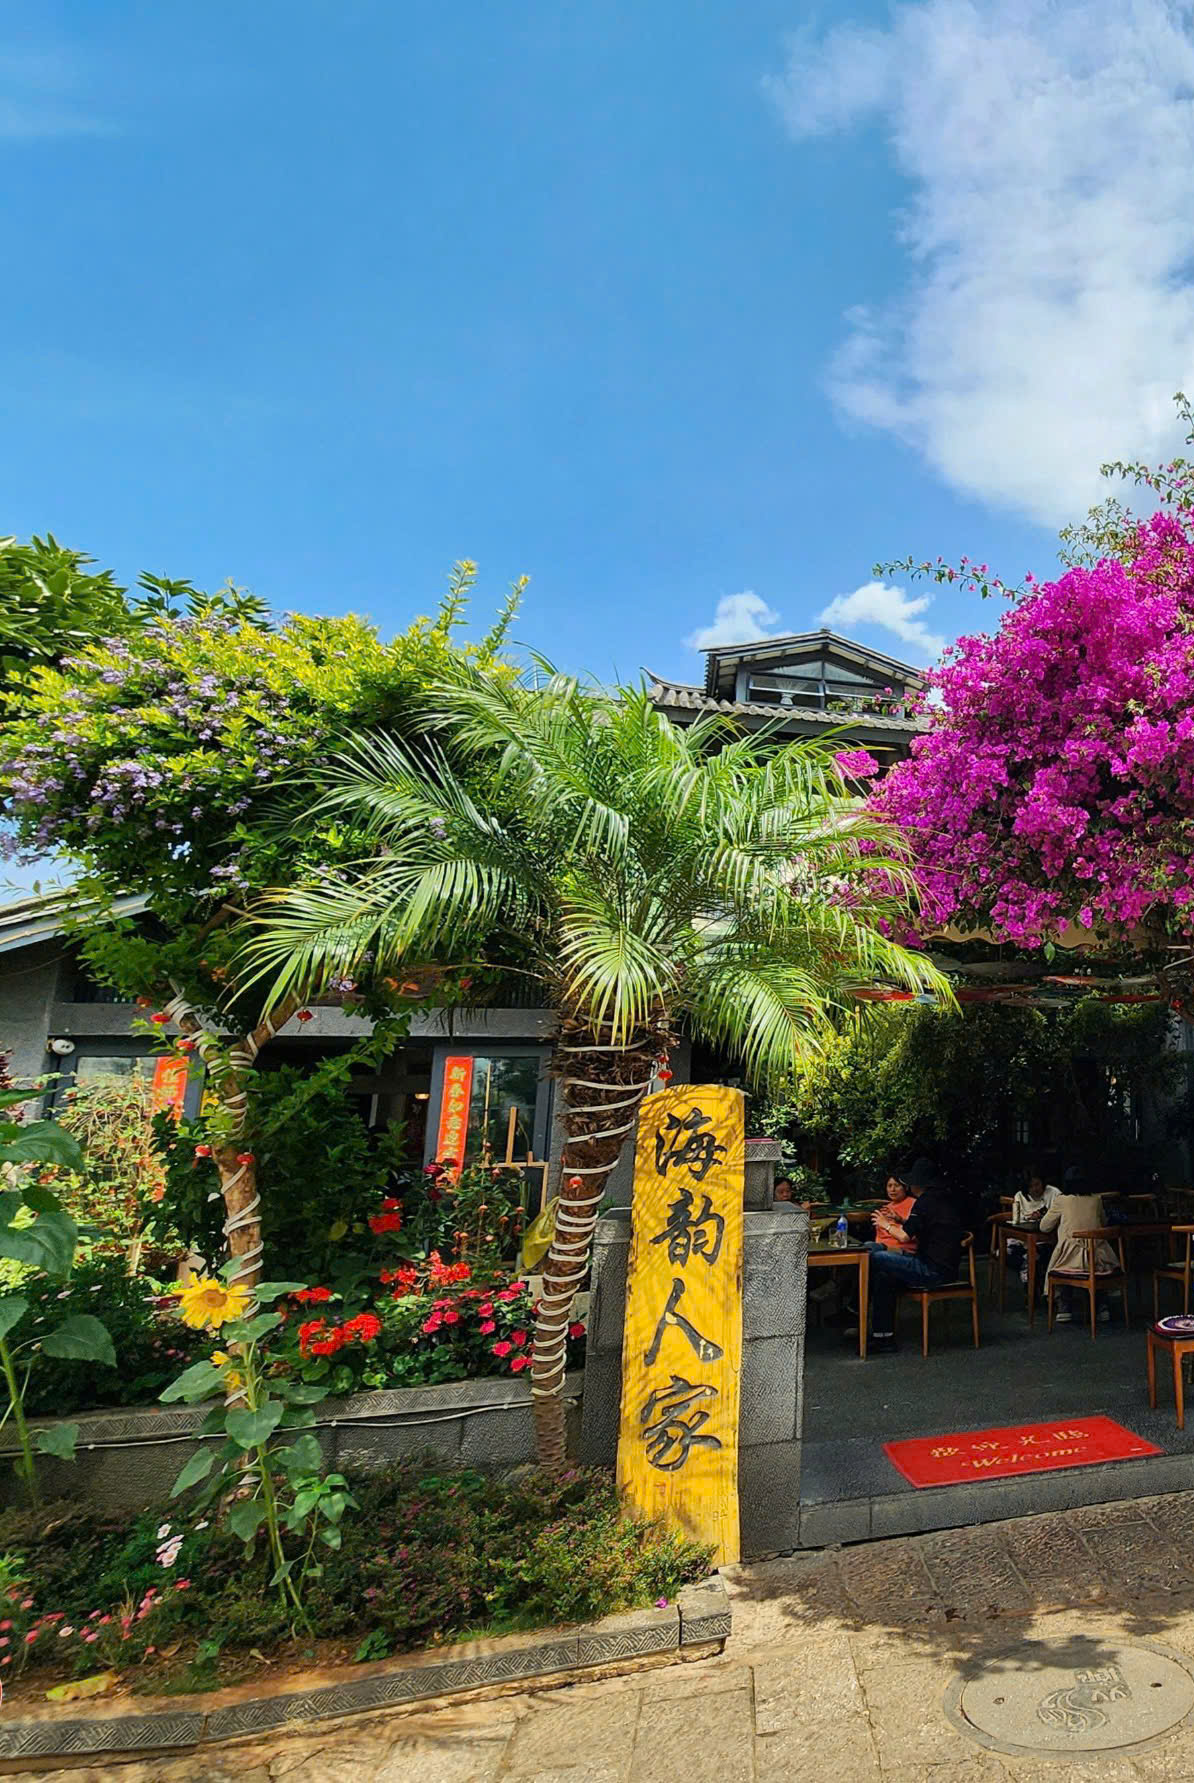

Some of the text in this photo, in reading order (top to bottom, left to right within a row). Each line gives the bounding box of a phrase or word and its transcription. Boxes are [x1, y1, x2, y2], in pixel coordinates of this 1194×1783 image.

[640, 1106, 728, 1473] 海韵人家
[971, 1447, 1083, 1468] Welcome
